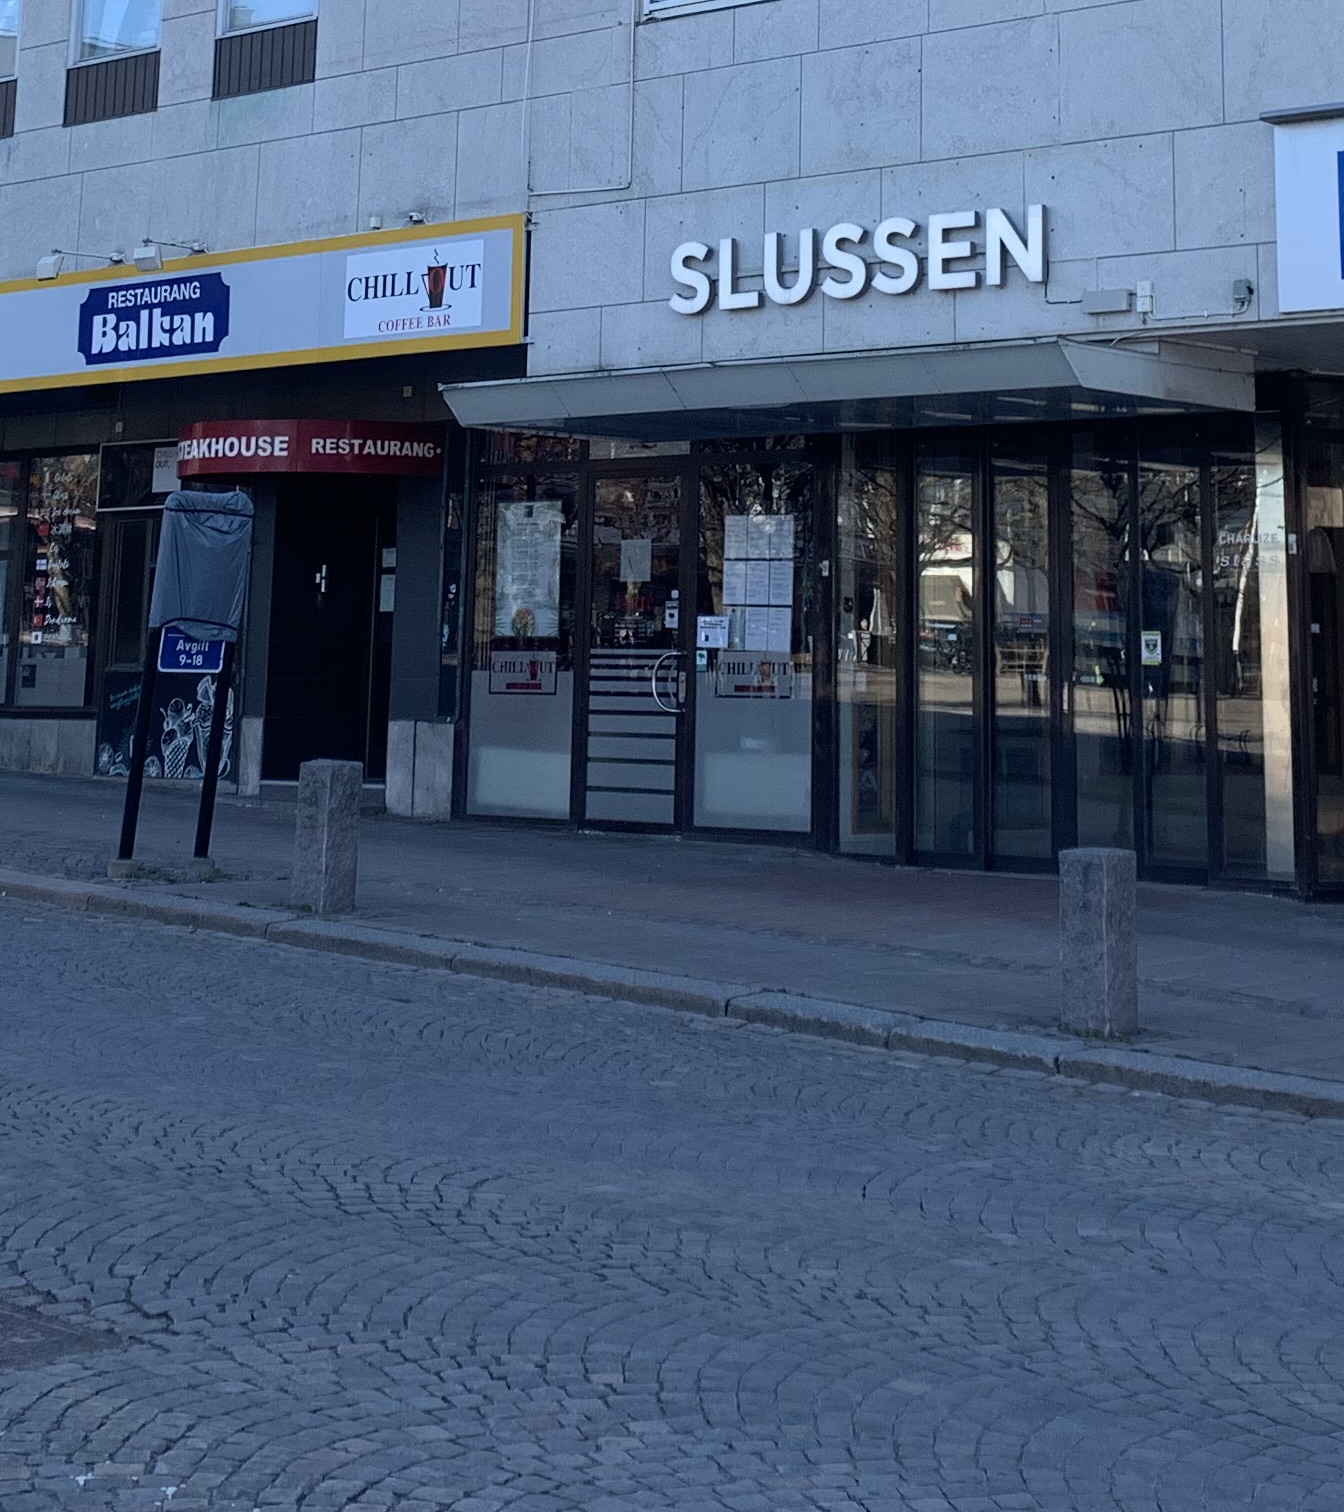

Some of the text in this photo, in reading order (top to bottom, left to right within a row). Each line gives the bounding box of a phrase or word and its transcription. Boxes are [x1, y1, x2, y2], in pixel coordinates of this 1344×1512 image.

[668, 203, 1049, 316] SLUSSEN
[108, 280, 201, 309] RESTAURANG
[347, 271, 419, 302] CHILL
[91, 307, 215, 354] Balkan
[378, 313, 452, 334] COFFEE BAR
[311, 438, 435, 459] RESTAURANG
[176, 639, 210, 654] Avgift
[179, 654, 203, 666] 9-18
[492, 660, 529, 674] CHILL
